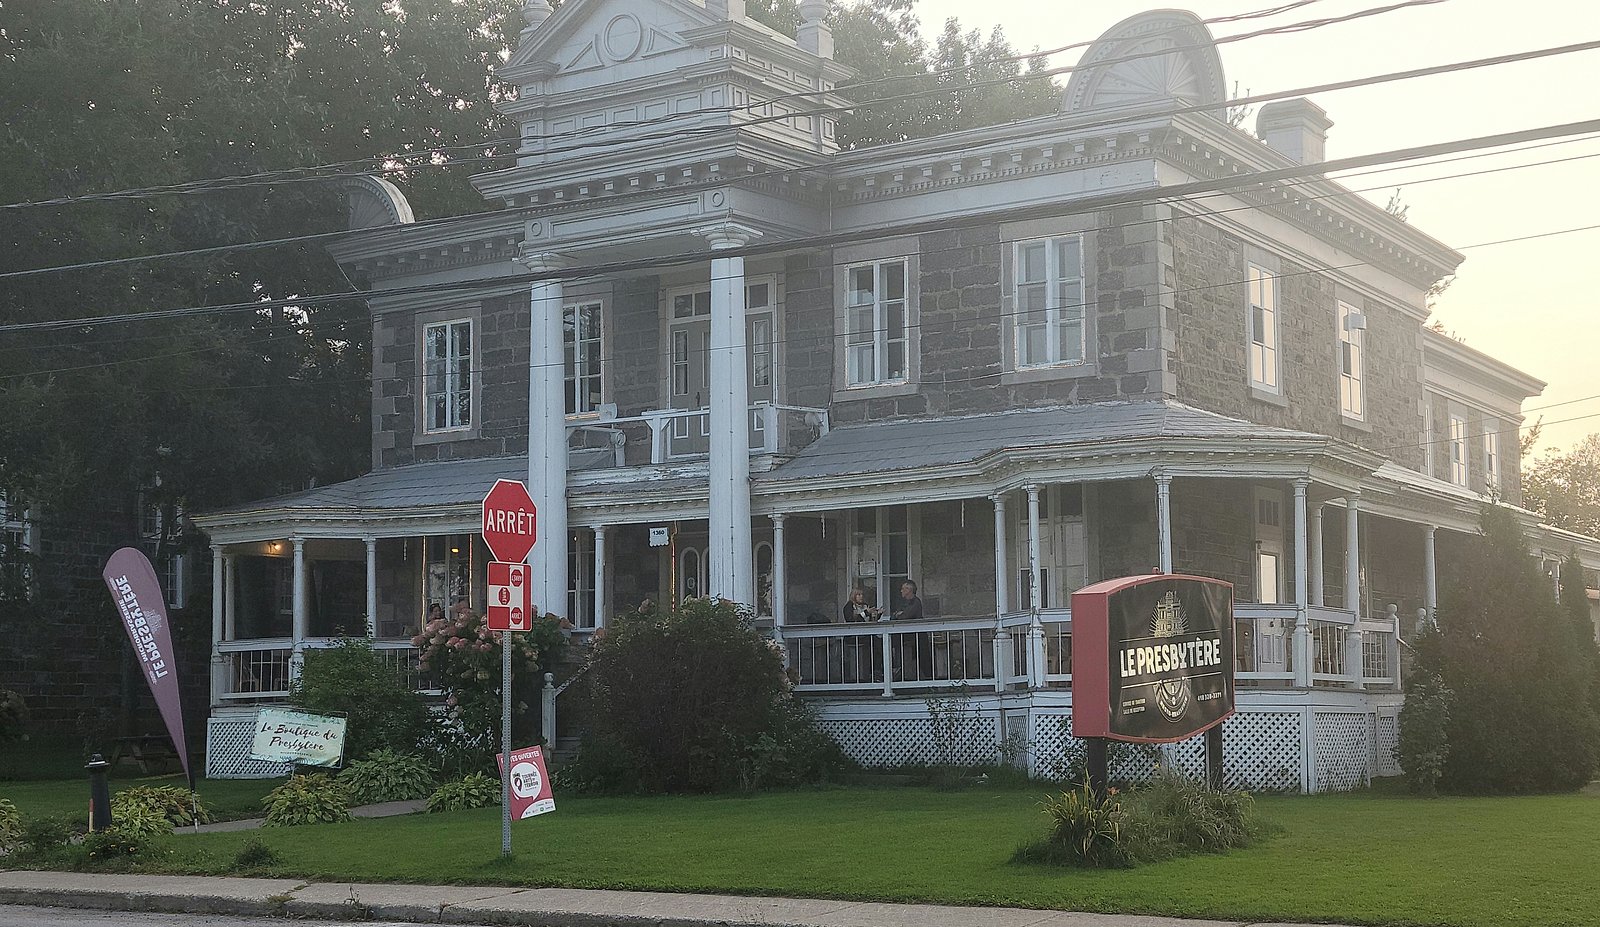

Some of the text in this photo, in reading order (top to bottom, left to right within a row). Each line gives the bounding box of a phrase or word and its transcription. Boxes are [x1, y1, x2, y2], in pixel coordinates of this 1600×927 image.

[486, 508, 535, 535] ARRÊT
[1120, 637, 1221, 678] LE PRESBYTÈRE
[274, 724, 320, 739] Boutique
[323, 729, 338, 740] du
